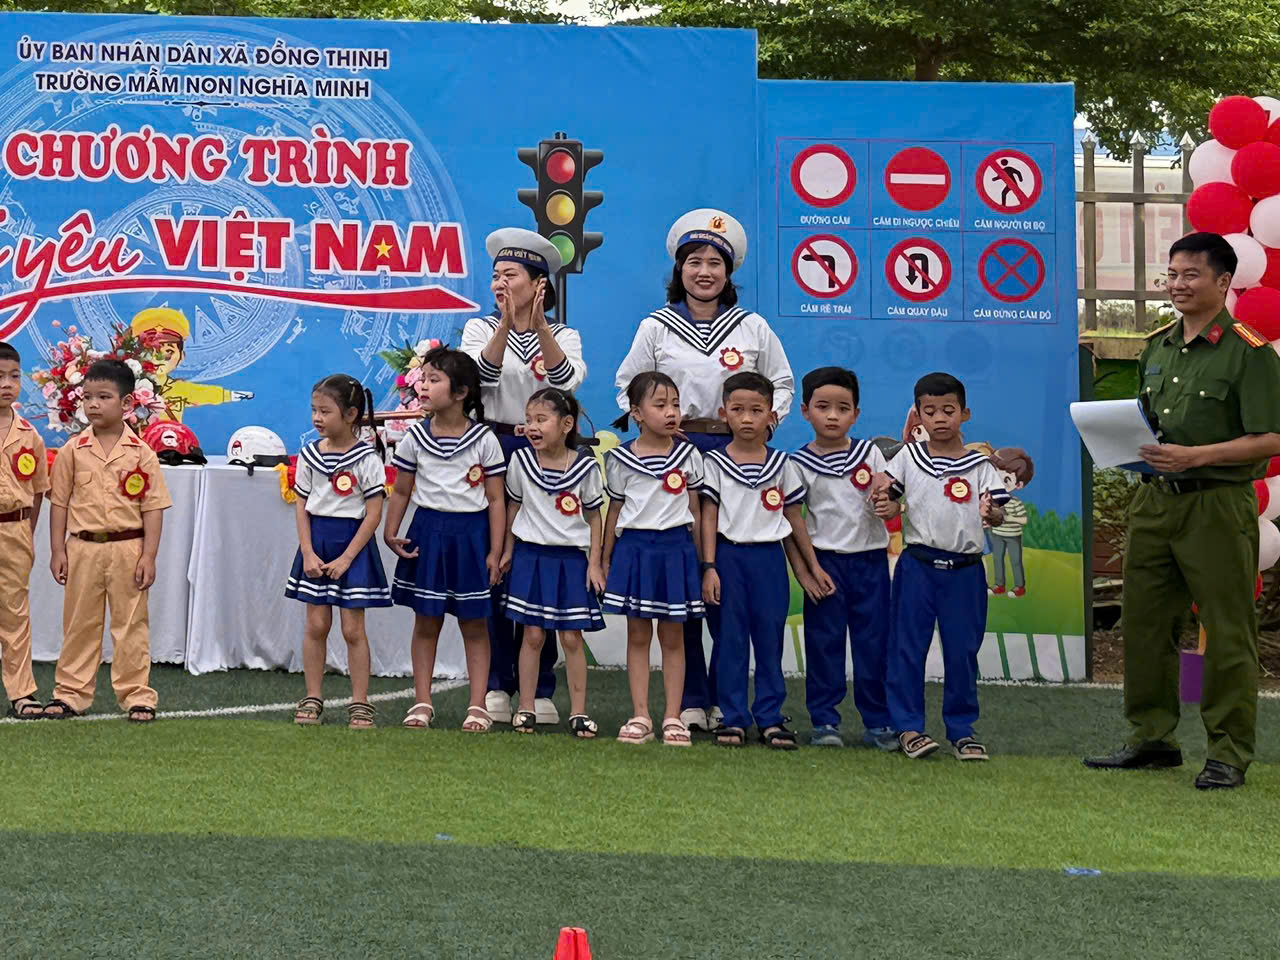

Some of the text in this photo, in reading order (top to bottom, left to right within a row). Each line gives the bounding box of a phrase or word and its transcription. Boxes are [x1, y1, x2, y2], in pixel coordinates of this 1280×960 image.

[19, 36, 388, 72] ỦY BAN NHÂN DÂN XÃ ĐỒNG THỊNH
[35, 67, 370, 98] TRƯỜNG MẦM NON NGHĨA MINH
[5, 126, 411, 186] CHƯƠNG TRÌNH
[153, 210, 291, 282] VIỆT
[314, 222, 465, 274] NAM
